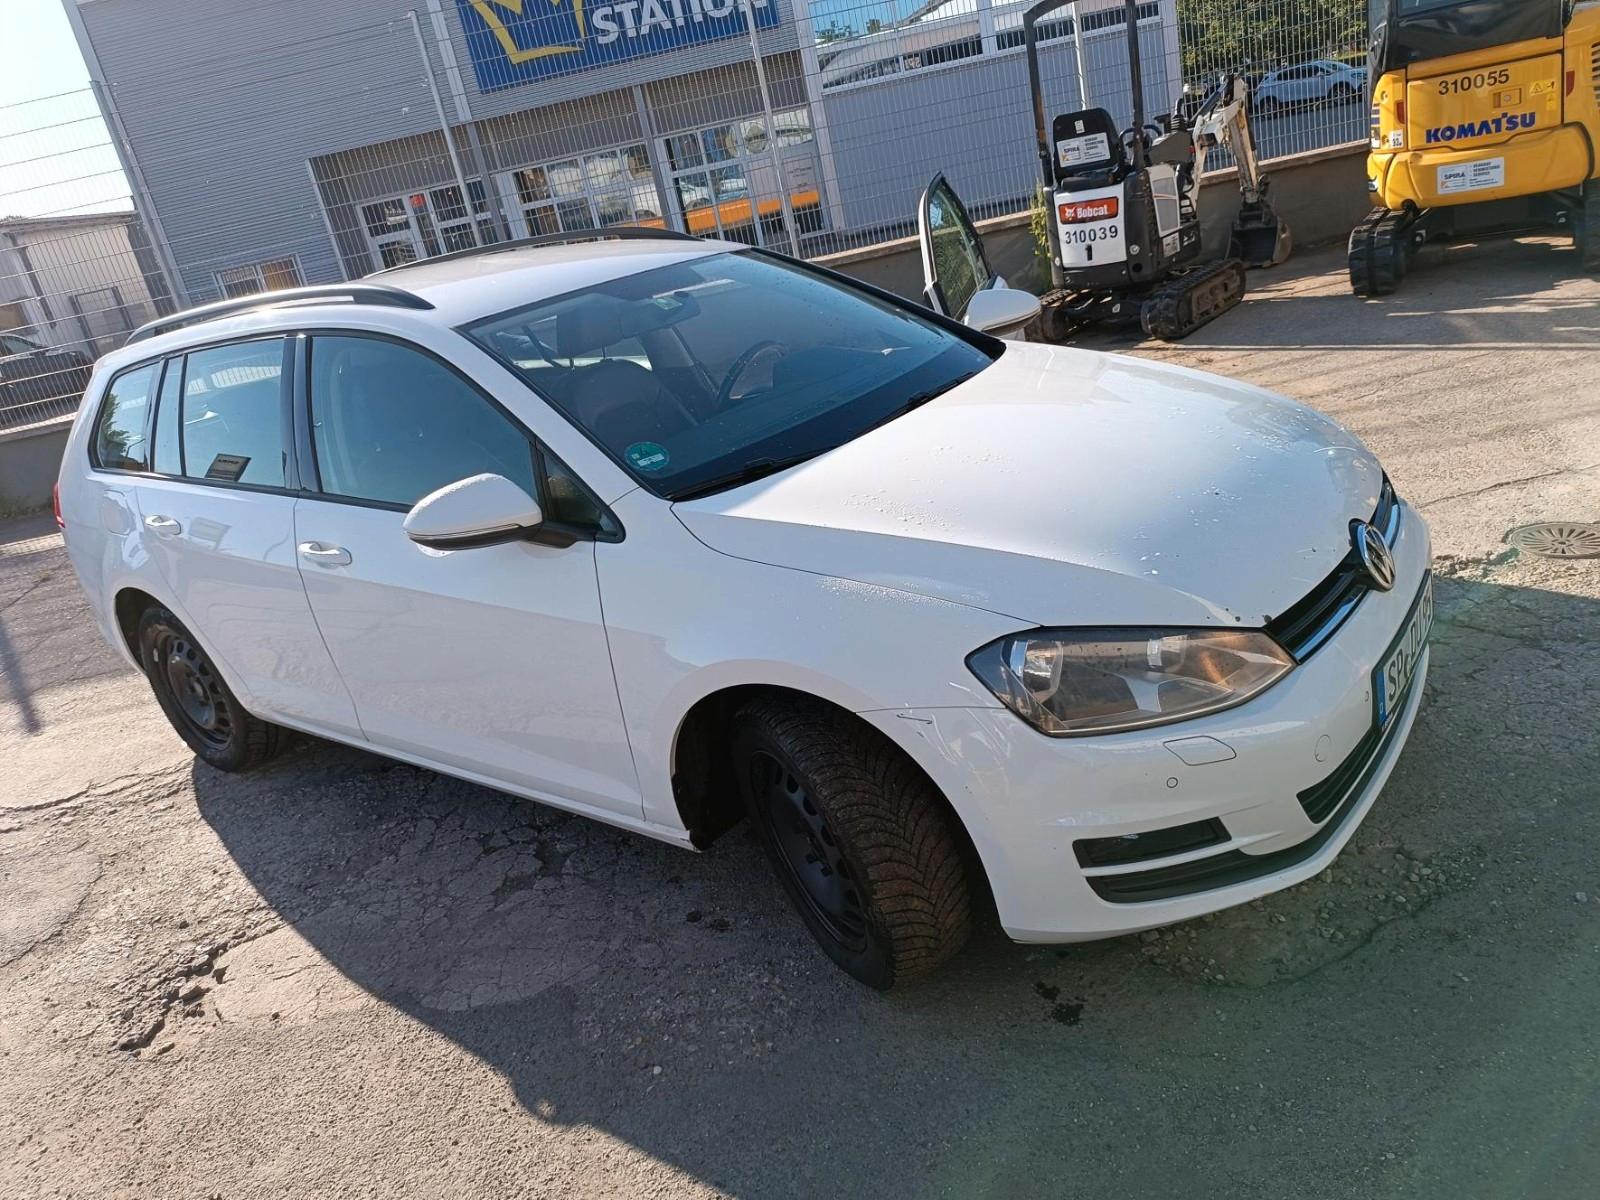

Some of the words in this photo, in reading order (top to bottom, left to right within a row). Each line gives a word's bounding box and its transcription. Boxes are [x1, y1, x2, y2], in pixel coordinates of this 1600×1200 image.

[592, 0, 768, 44] STATI
[1438, 69, 1510, 95] 310055
[1425, 111, 1536, 144] KOMATSU
[1076, 204, 1108, 219] Bobcat
[1064, 225, 1118, 245] 310039
[1085, 243, 1093, 261] 1
